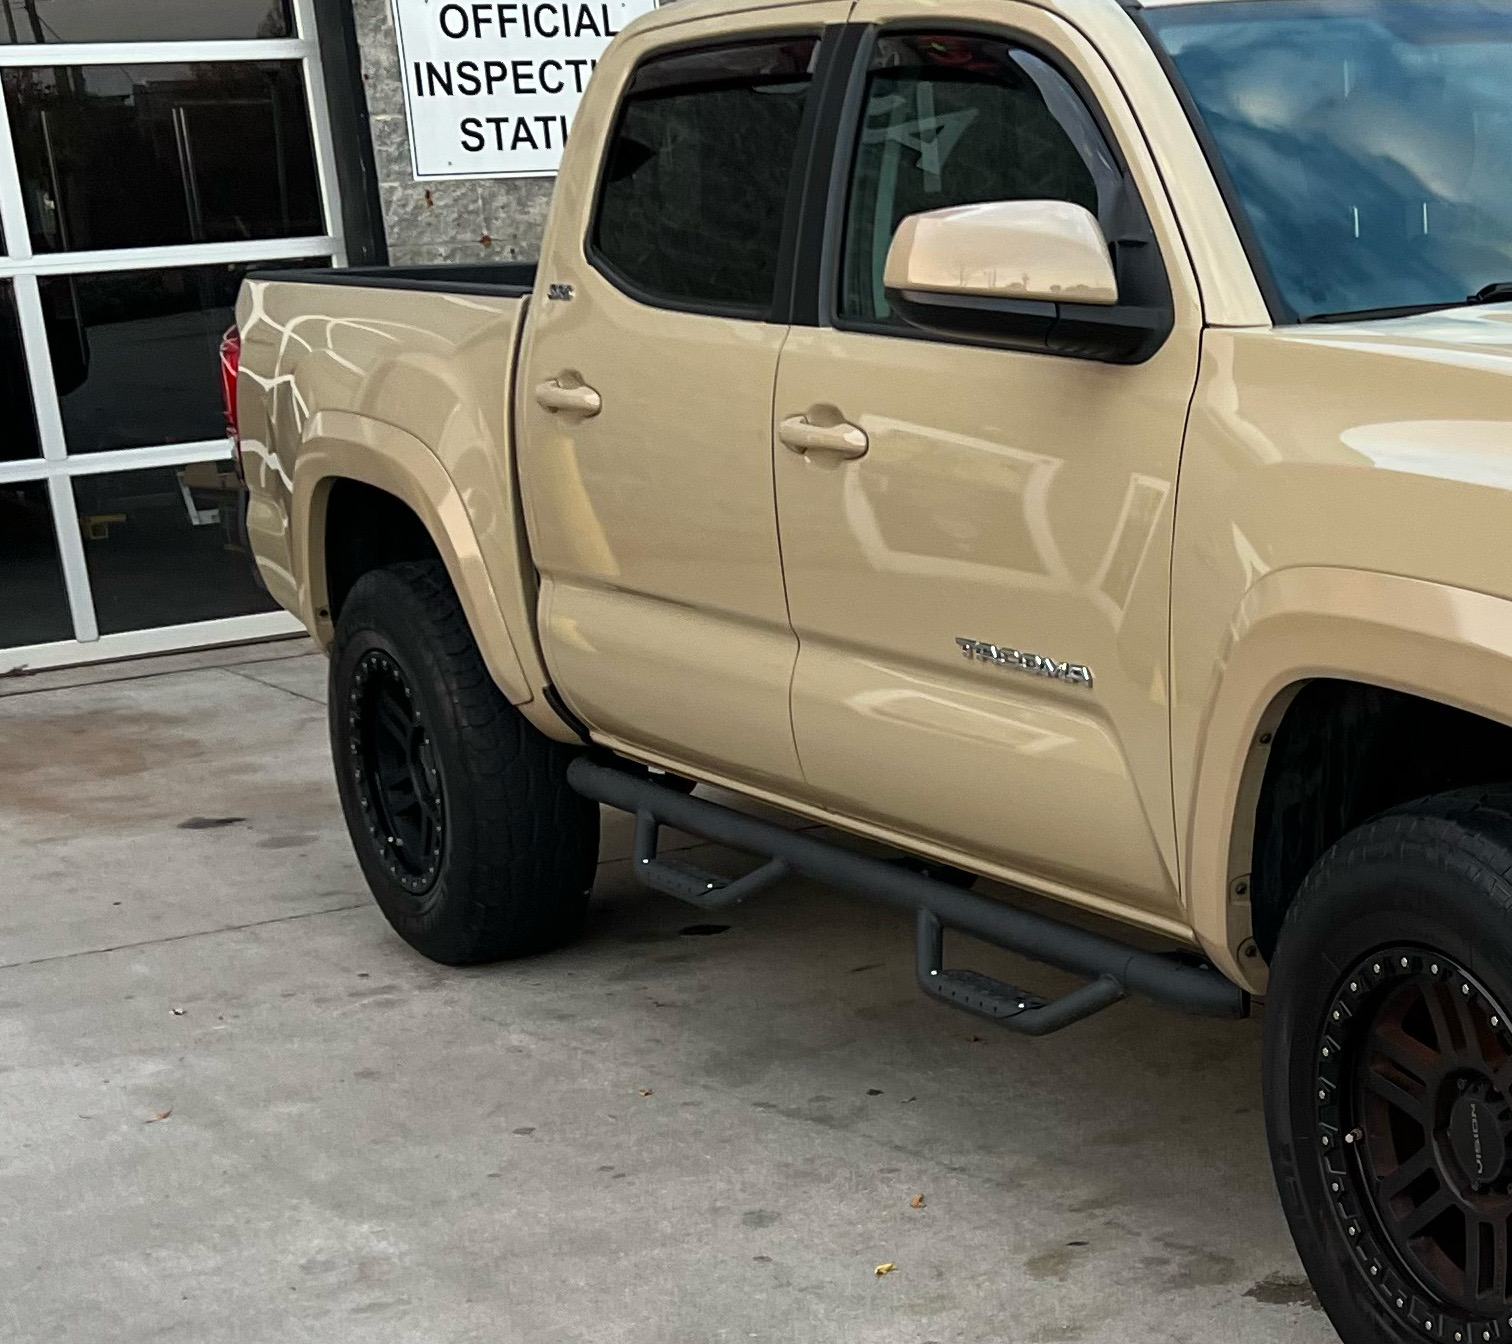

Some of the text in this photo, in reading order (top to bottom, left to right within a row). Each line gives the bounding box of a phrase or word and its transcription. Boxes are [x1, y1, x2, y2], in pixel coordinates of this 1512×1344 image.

[439, 3, 620, 39] OFFICIAL
[413, 59, 597, 97] INSPECT
[1470, 1103, 1483, 1174] VISION
